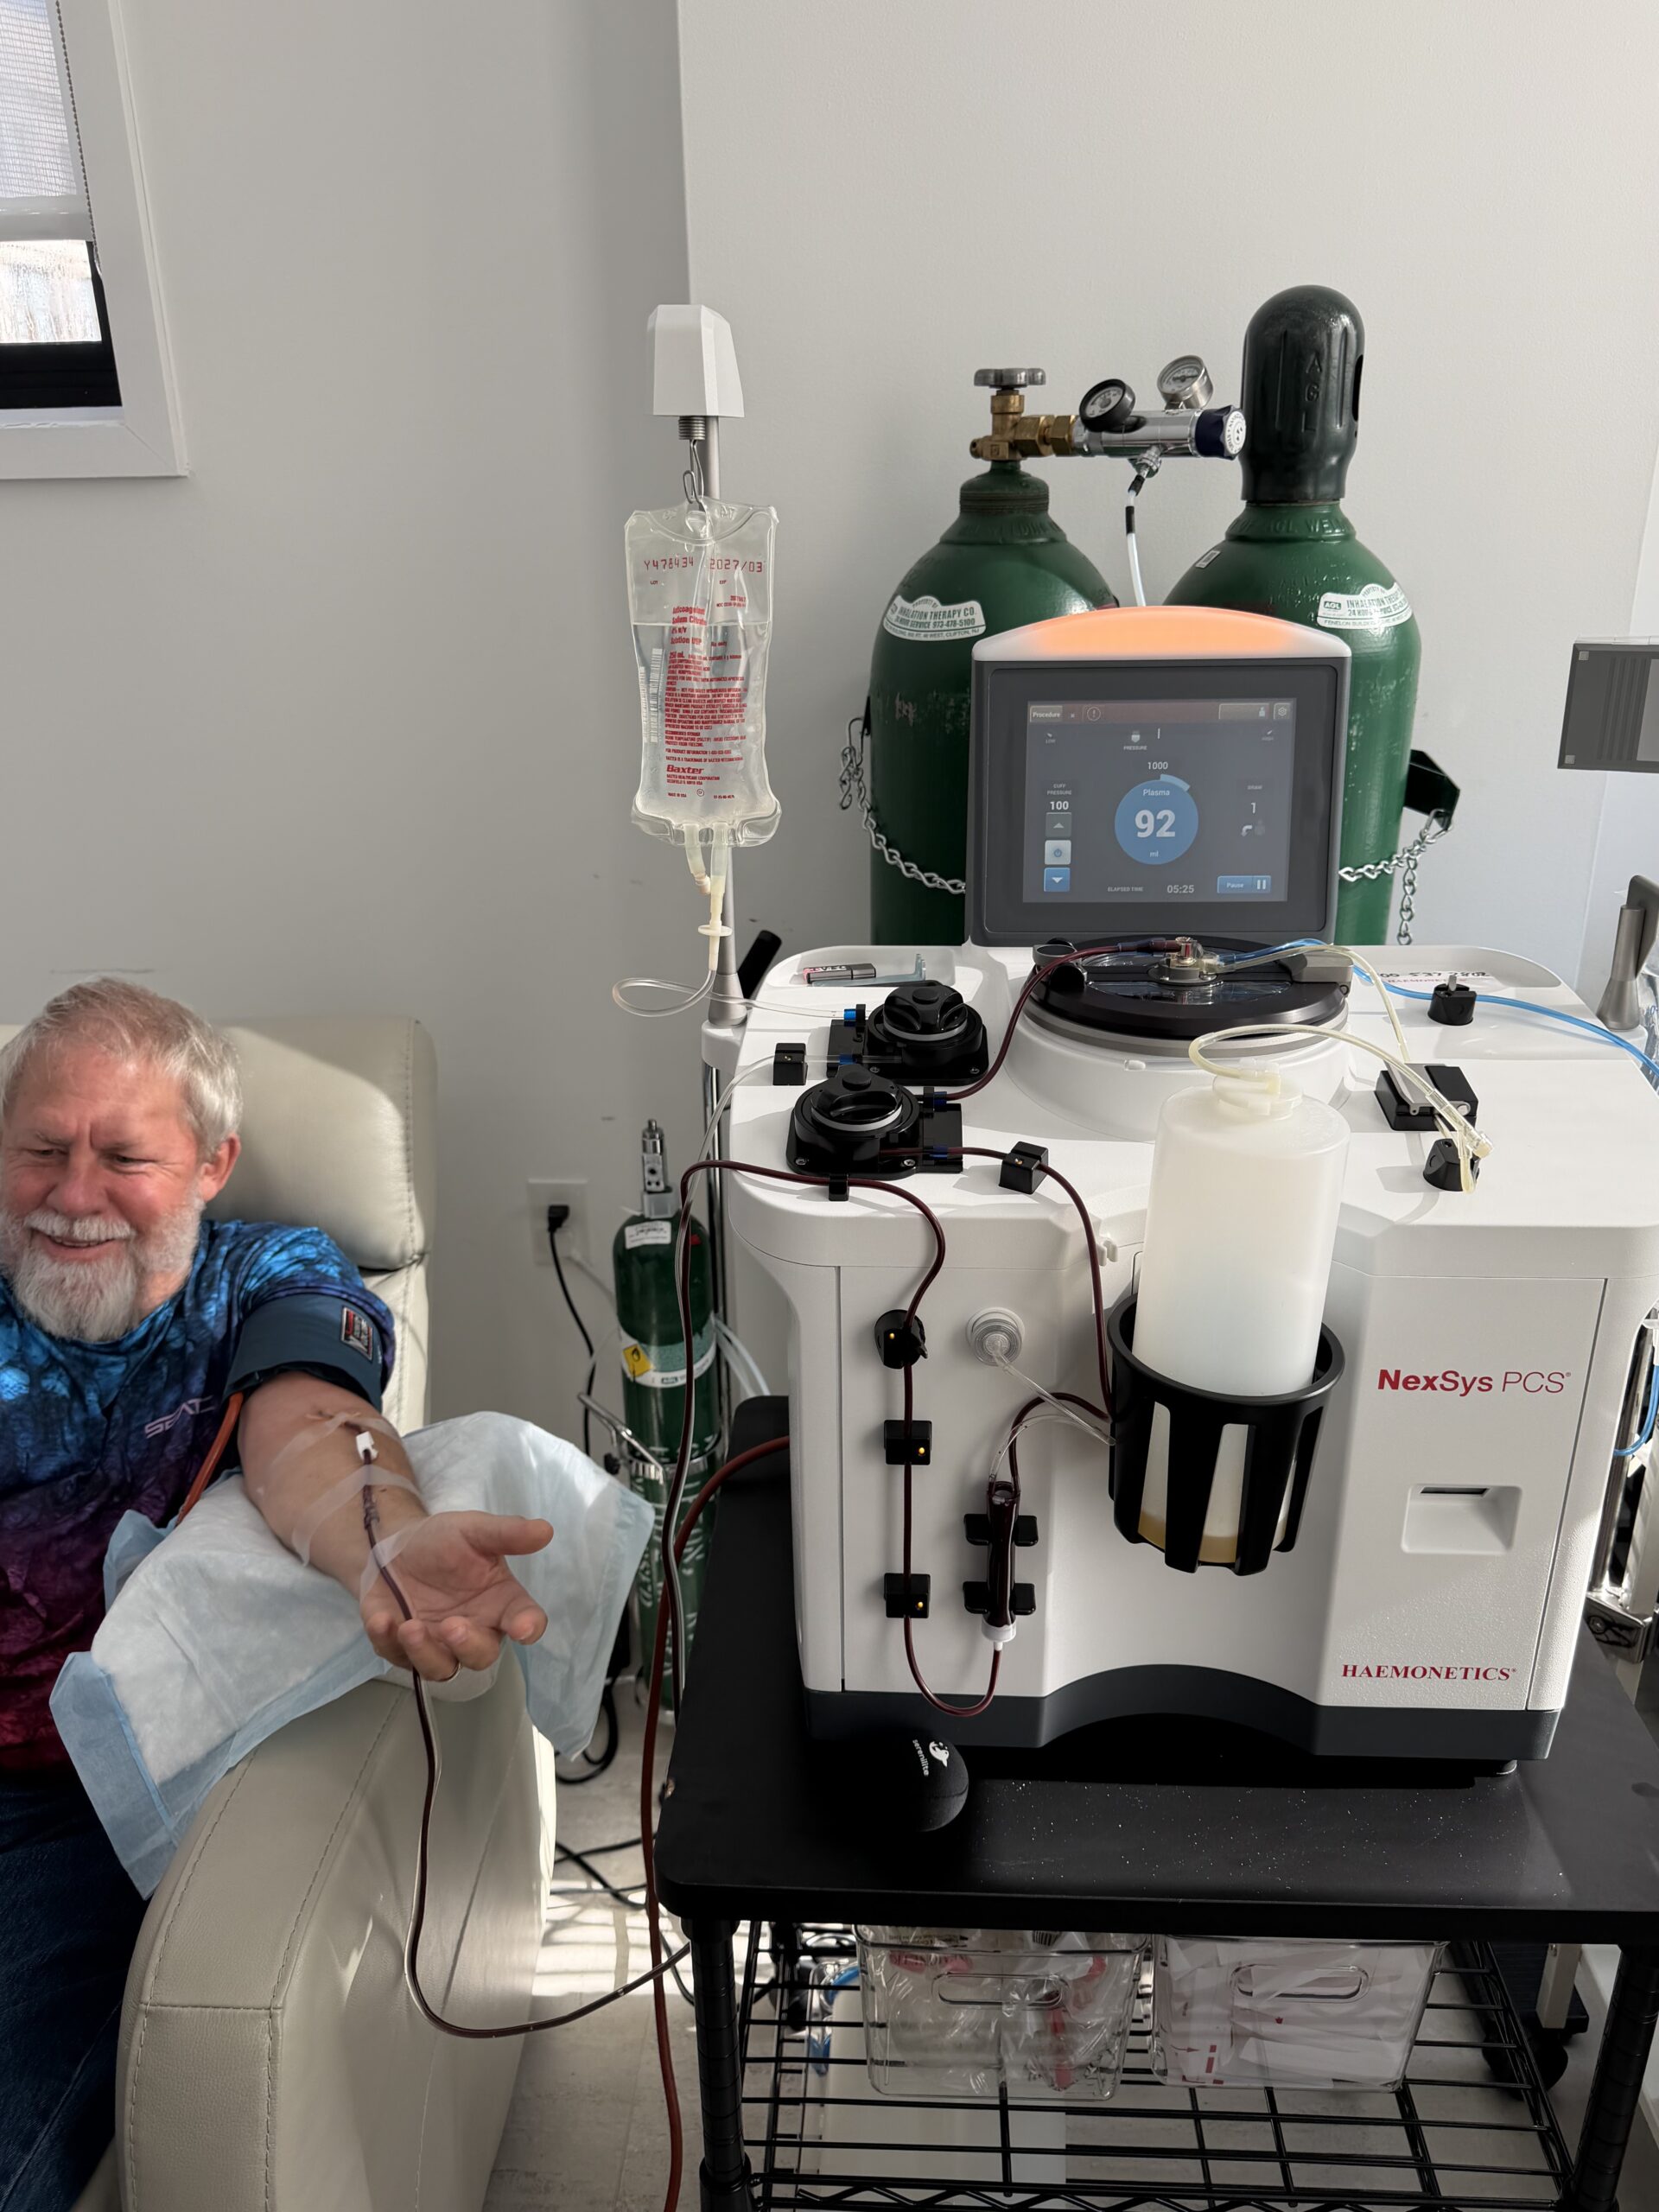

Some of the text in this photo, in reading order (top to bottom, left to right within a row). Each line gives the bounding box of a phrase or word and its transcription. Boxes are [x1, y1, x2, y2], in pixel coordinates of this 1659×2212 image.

[644, 556, 763, 573] Y478434 2027/03
[930, 608, 963, 620] THERAPY
[666, 764, 705, 775] Baxter
[1147, 761, 1169, 771] 1000
[1142, 788, 1171, 798] Plasma
[1049, 800, 1070, 811] 100
[1134, 809, 1176, 838] 92
[1166, 884, 1195, 894] 05:25
[1376, 1368, 1494, 1397] NexSys
